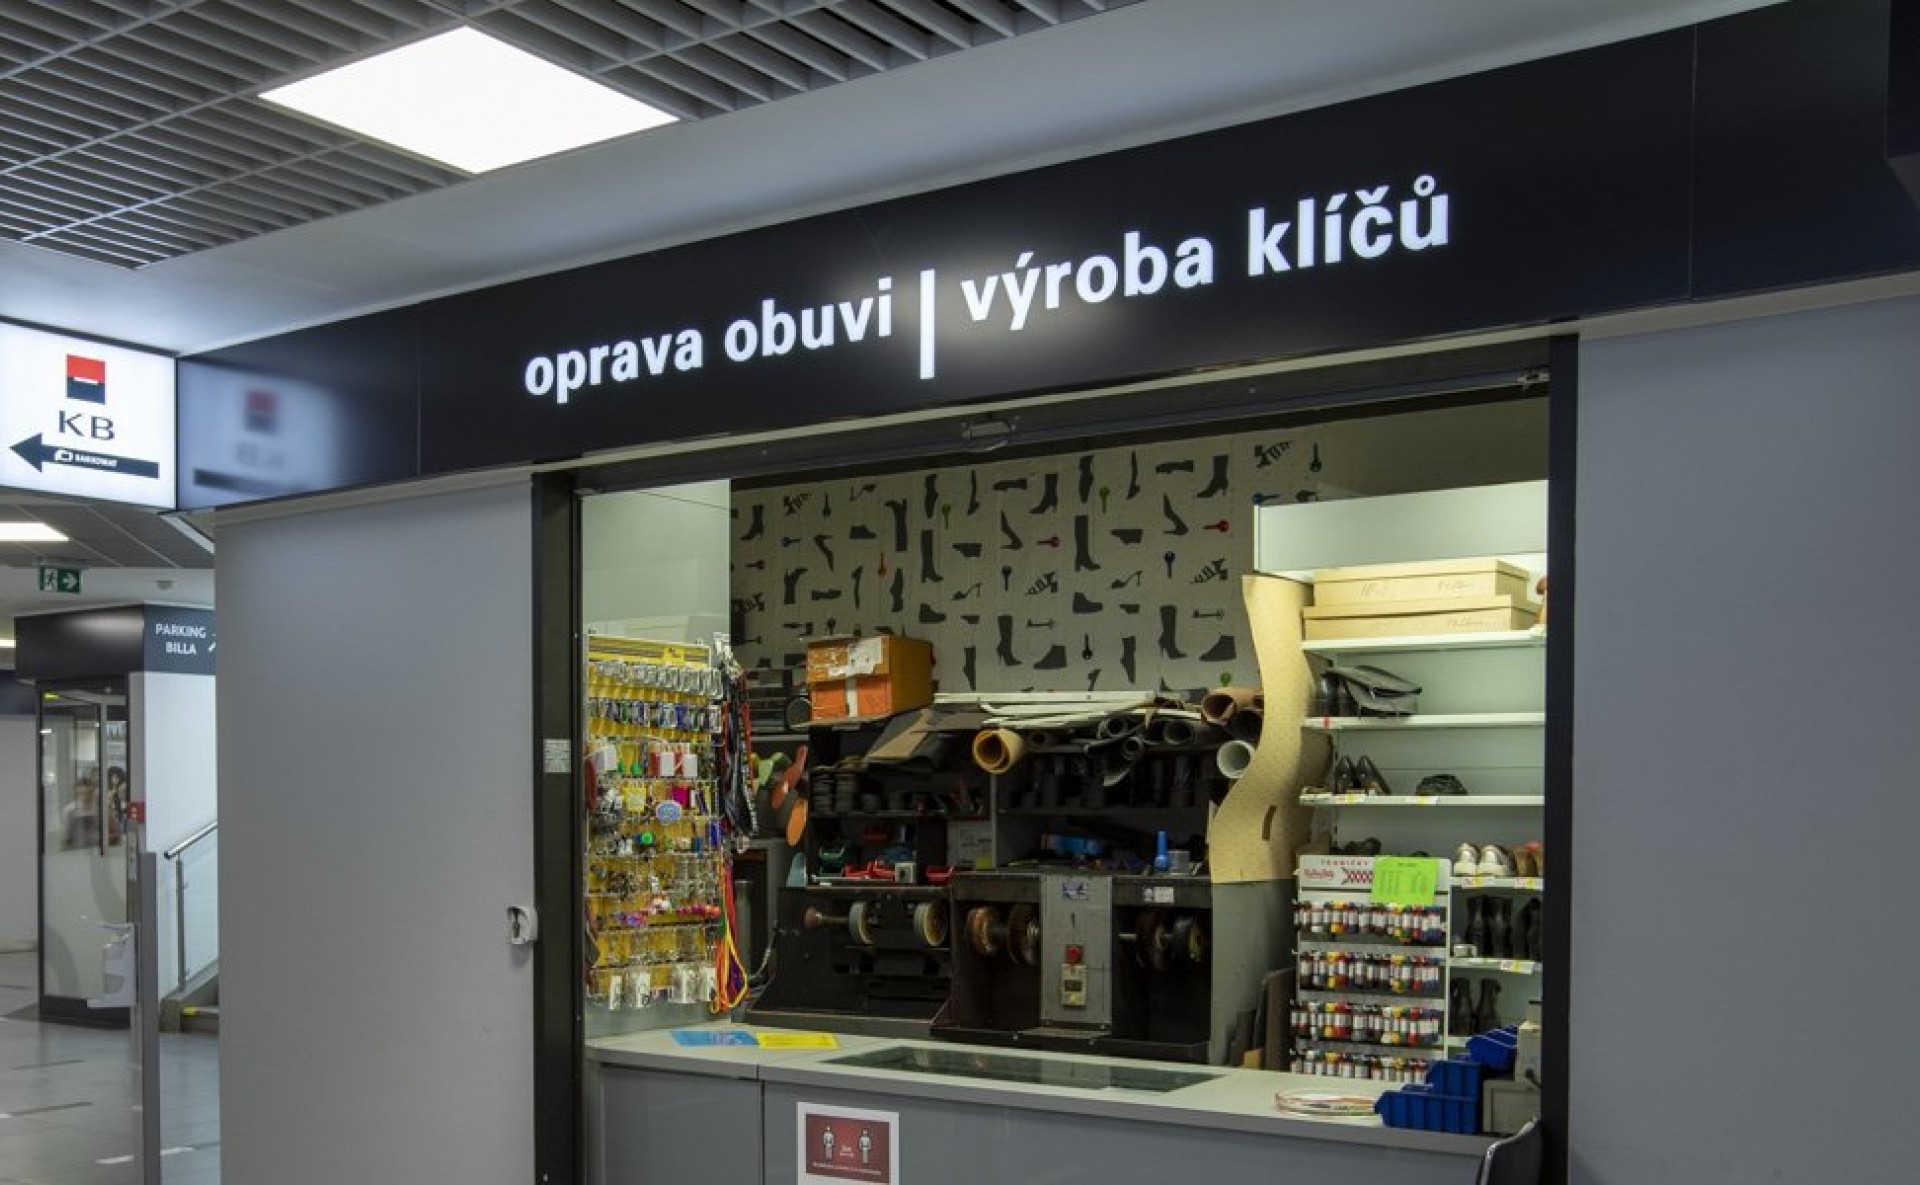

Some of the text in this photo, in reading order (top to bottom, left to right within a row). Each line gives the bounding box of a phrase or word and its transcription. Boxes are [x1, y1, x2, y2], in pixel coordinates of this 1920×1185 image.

[524, 174, 1449, 404] oprava obuvi výroba klíčů
[59, 411, 115, 440] KB
[155, 623, 206, 638] PARKING
[165, 641, 197, 654] BILLA
